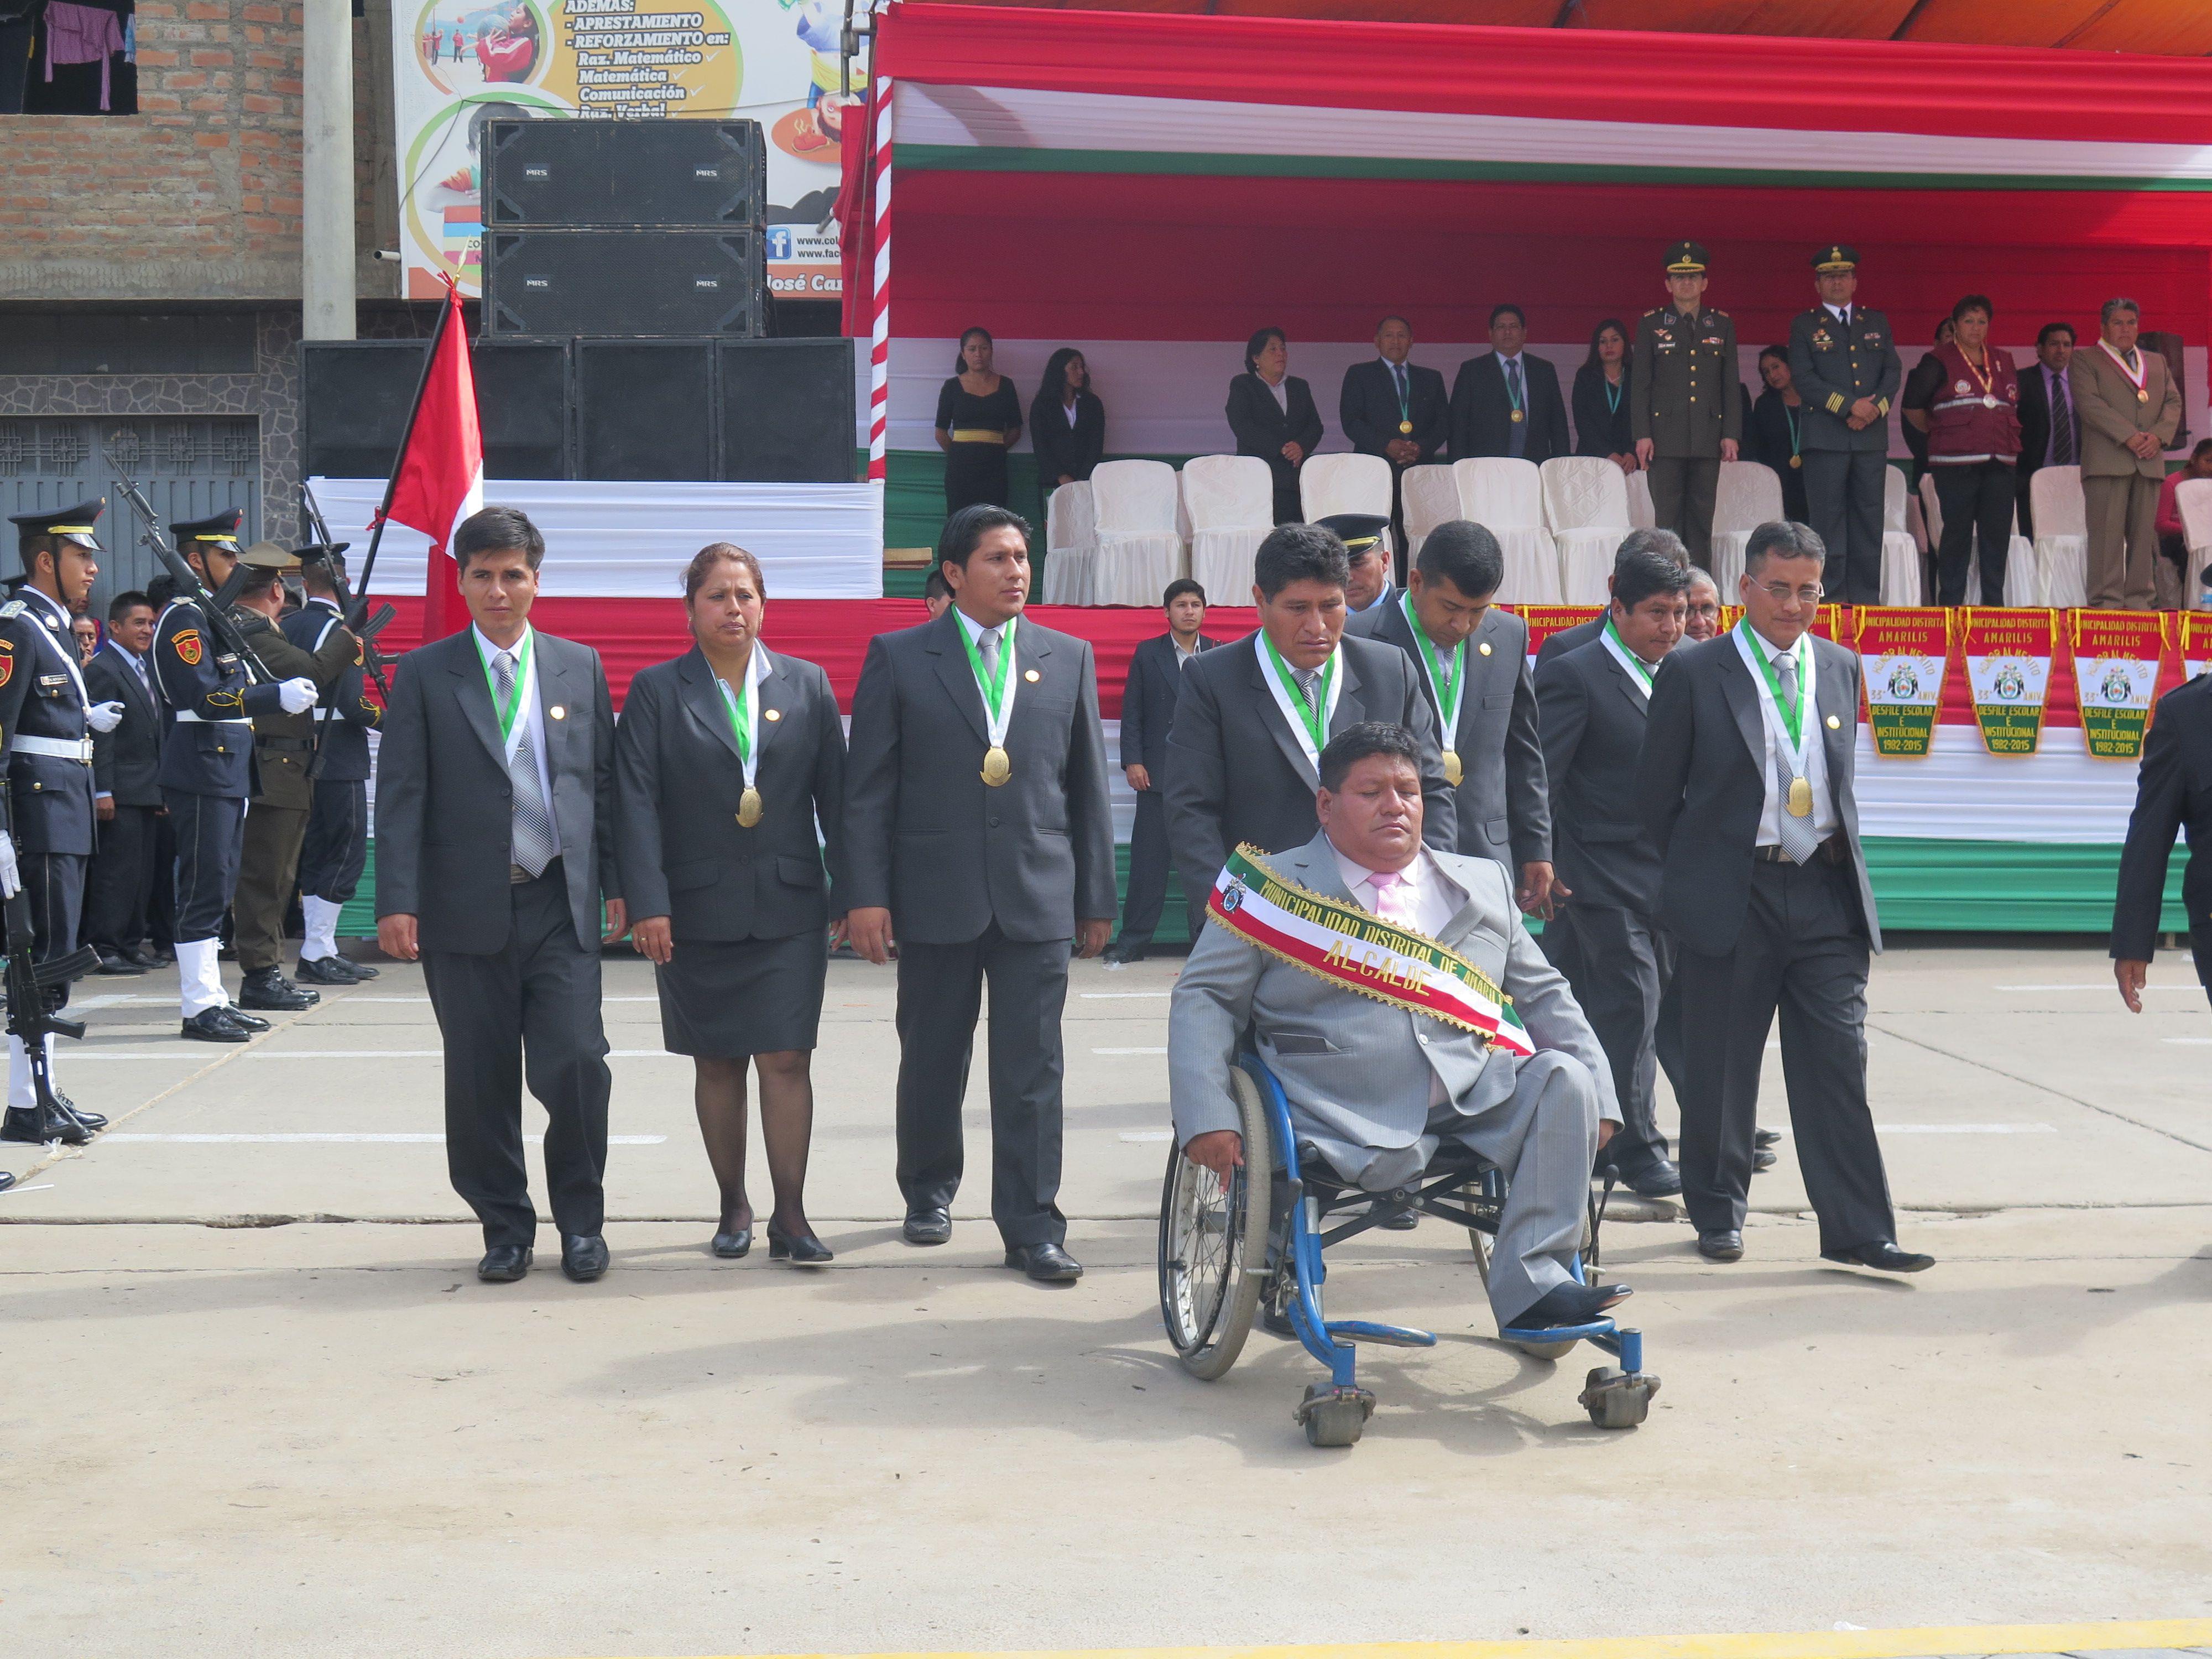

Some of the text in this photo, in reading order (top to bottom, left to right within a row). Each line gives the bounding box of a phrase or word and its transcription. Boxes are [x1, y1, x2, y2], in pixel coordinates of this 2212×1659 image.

[574, 13, 703, 30] APRESTAMIENTO
[574, 32, 703, 48] REFORZAMIENTO
[706, 33, 729, 45] en:
[578, 49, 702, 66] Raz. Matemático
[578, 67, 667, 84] Matemática
[580, 85, 685, 101] Comunicación
[1527, 616, 1575, 627] UNICIPALIDAD
[1865, 617, 1945, 627] UNICIPALIDAD DISTRITA
[2018, 618, 2049, 629] DISTRITA
[1879, 631, 1928, 643] AMARILIS
[1984, 632, 2032, 643] AMARILIS
[2092, 634, 2141, 646] AMARILIS
[1872, 706, 1933, 716] DESFILE ESCOLAR
[1978, 706, 2040, 716] DESFILE ESCOLAR
[2085, 708, 2146, 719] DESFILE ESCOLAR
[1900, 716, 1905, 726] E
[2006, 716, 2011, 726] E
[2111, 719, 2117, 729] E
[1877, 727, 1928, 738] INSTITUCIONAL
[1984, 726, 2035, 737] INSTITUCIONAL
[2089, 728, 2140, 740] INSTITUCIONAL
[1883, 740, 1922, 750] 1982-2015
[1991, 739, 2030, 750] 1982-2015
[2095, 741, 2134, 753] 1982-2015
[1259, 878, 1361, 938] MUNICIPALIDAD
[1363, 925, 1432, 966] DISTRITAL
[1439, 956, 1458, 977] DE
[1322, 940, 1432, 997] ALCALDE
